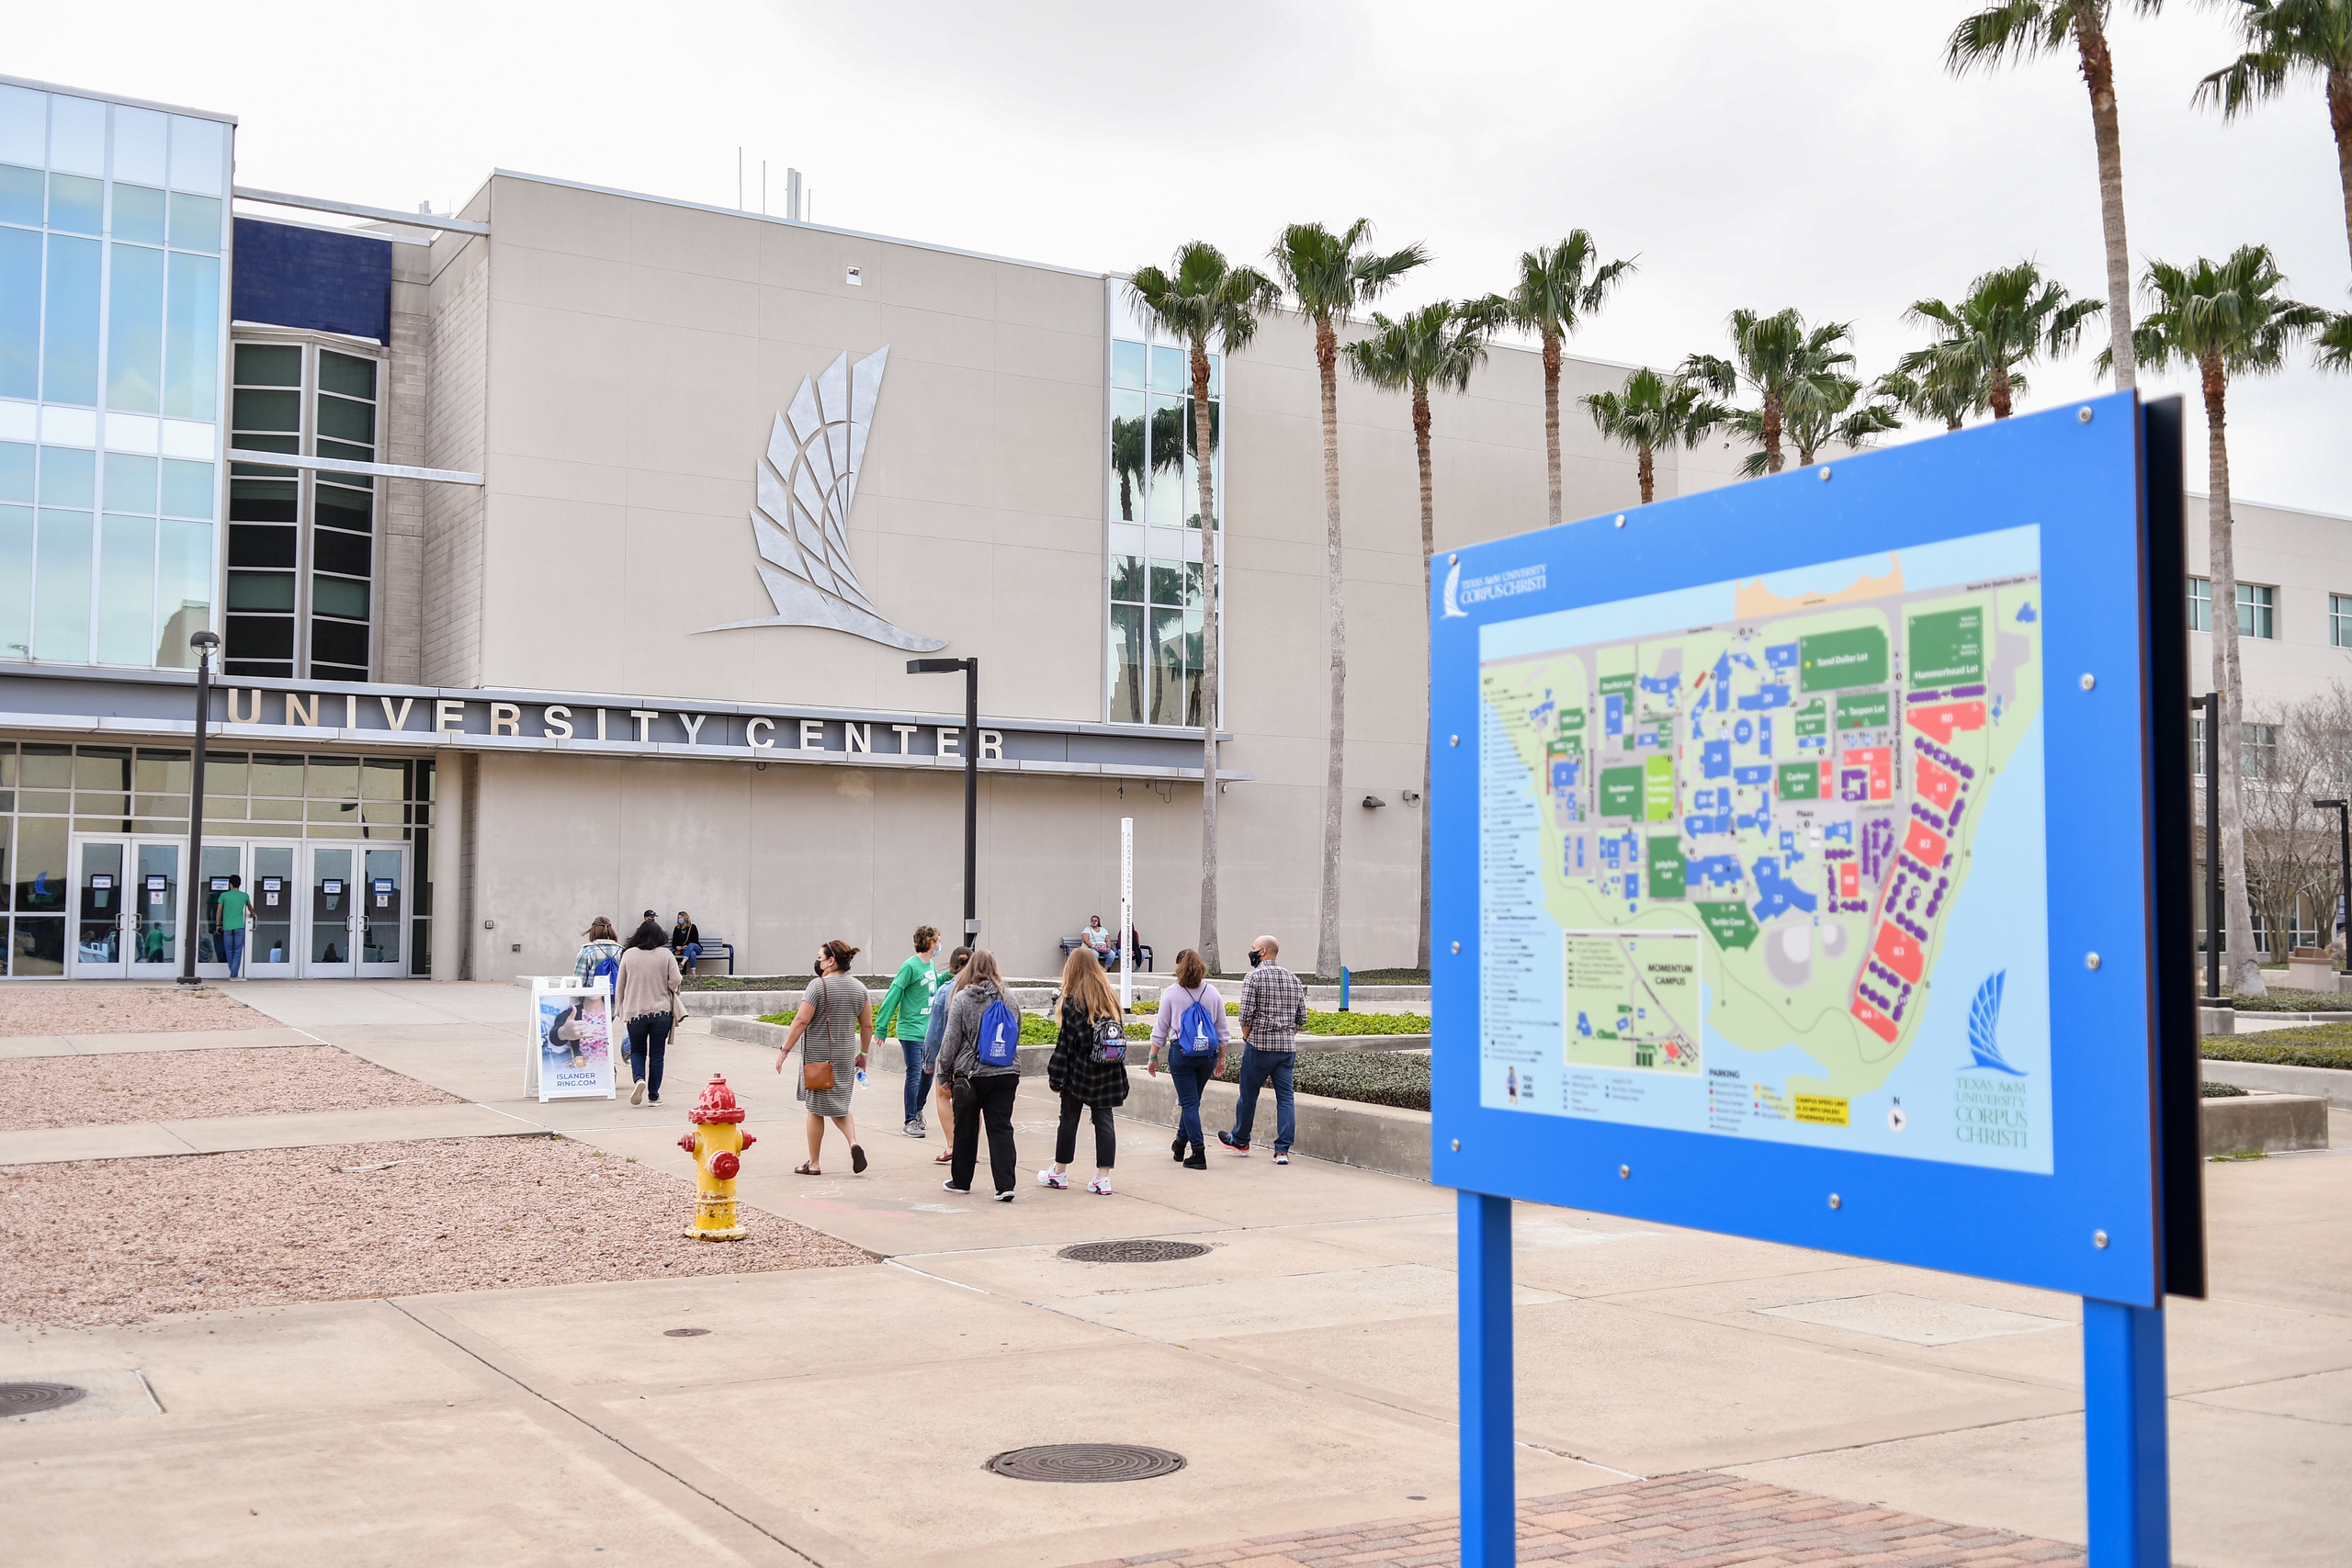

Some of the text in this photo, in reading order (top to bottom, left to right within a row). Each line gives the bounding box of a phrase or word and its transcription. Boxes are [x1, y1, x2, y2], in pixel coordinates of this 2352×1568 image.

[1461, 576, 1485, 590] TEXAS
[1502, 563, 1547, 581] UNIVERSITY
[1992, 578, 2012, 587] Station
[1461, 574, 1547, 604] CORPUS CHRISTI
[1779, 651, 1788, 660] 19
[1817, 653, 1868, 666] Sand Dollar Lot
[1915, 664, 1979, 680] Hammerhead Lot
[1602, 682, 1623, 690] Starfish
[1659, 682, 1668, 690] 15
[1719, 681, 1727, 689] 17
[1764, 694, 1774, 703] 20
[1849, 705, 1886, 716] Tarpon Lot
[1796, 713, 1826, 721] Seabreeze
[227, 688, 1003, 760] UNIVERSITY CENTER
[1738, 727, 1748, 736] 22
[1760, 731, 1770, 739] 21
[1807, 738, 1817, 747] 36
[1713, 753, 1722, 762] 24
[1863, 752, 1873, 761] R6
[1748, 771, 1758, 780] 25
[1787, 773, 1810, 781] Curlew
[1822, 775, 1832, 784] R7
[1793, 784, 1804, 792] Lot
[1875, 779, 1886, 788] R5
[1938, 784, 1947, 792] R1
[1609, 784, 1634, 793] Seahorse
[1699, 795, 1708, 804] 28
[1847, 792, 1855, 800] 39
[1720, 806, 1729, 815] 27
[1758, 812, 1769, 821] 26
[1694, 819, 1703, 829] 29
[1838, 826, 1849, 835] 35
[1782, 836, 1792, 845] 34
[1920, 840, 1931, 849] R2
[1656, 861, 1679, 870] Jellyfish
[1713, 864, 1723, 873] 30
[1661, 871, 1672, 879] Lot
[1762, 866, 1770, 875] 31
[1912, 888, 1920, 897] 39
[1774, 895, 1783, 903] 32
[1711, 918, 1746, 927] Turtle Cove
[1724, 929, 1734, 937] Lot
[1894, 947, 1905, 956] R3
[1648, 964, 1693, 973] MOMENTUM
[1656, 976, 1687, 986] CAMPUS
[1861, 1010, 1871, 1019] R4
[1709, 1068, 1740, 1078] PARKING
[1955, 1077, 2027, 1094] TEXAS A&M
[1893, 1096, 1900, 1106] N
[1955, 1091, 2027, 1108] UNIVERSITY
[1796, 1113, 1846, 1124] OTHERWISE POSTED
[1955, 1105, 2029, 1129] CORPUS
[1956, 1124, 2028, 1149] CHRISTI
